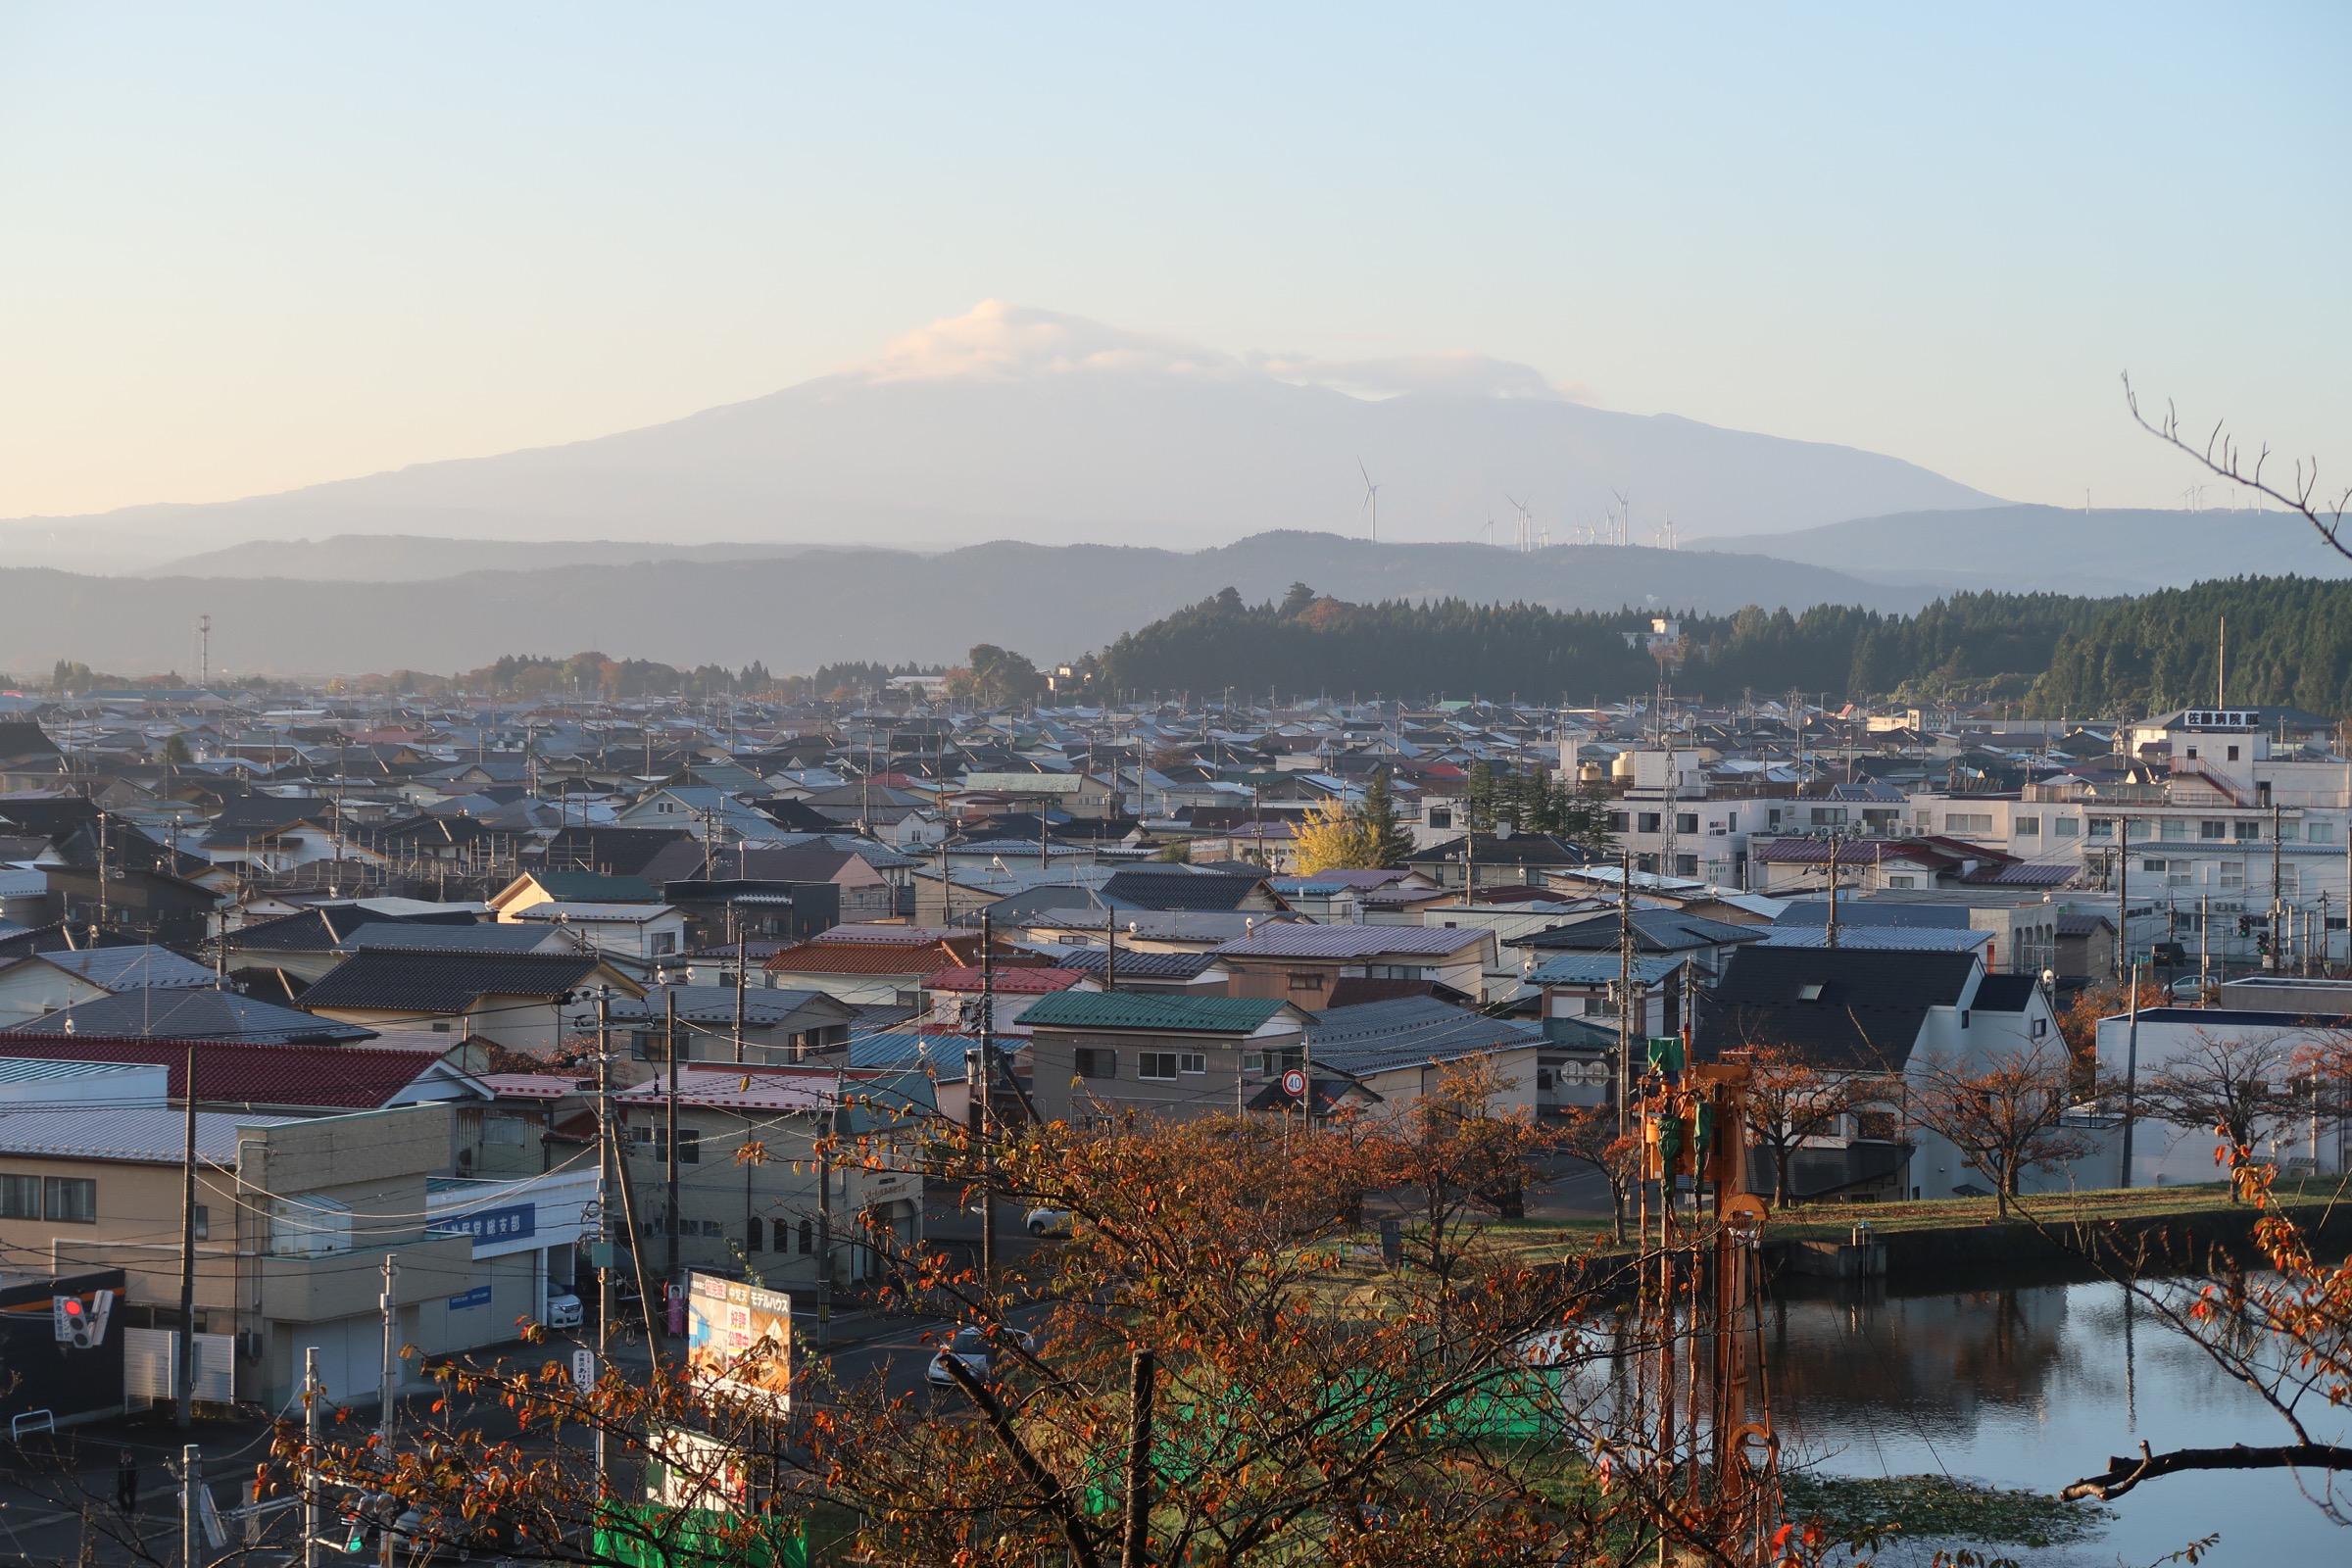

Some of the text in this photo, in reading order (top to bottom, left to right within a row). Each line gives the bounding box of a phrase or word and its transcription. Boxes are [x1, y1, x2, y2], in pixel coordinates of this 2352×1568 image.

[1288, 1077, 1301, 1090] 40
[751, 1291, 789, 1313] モデルハウス
